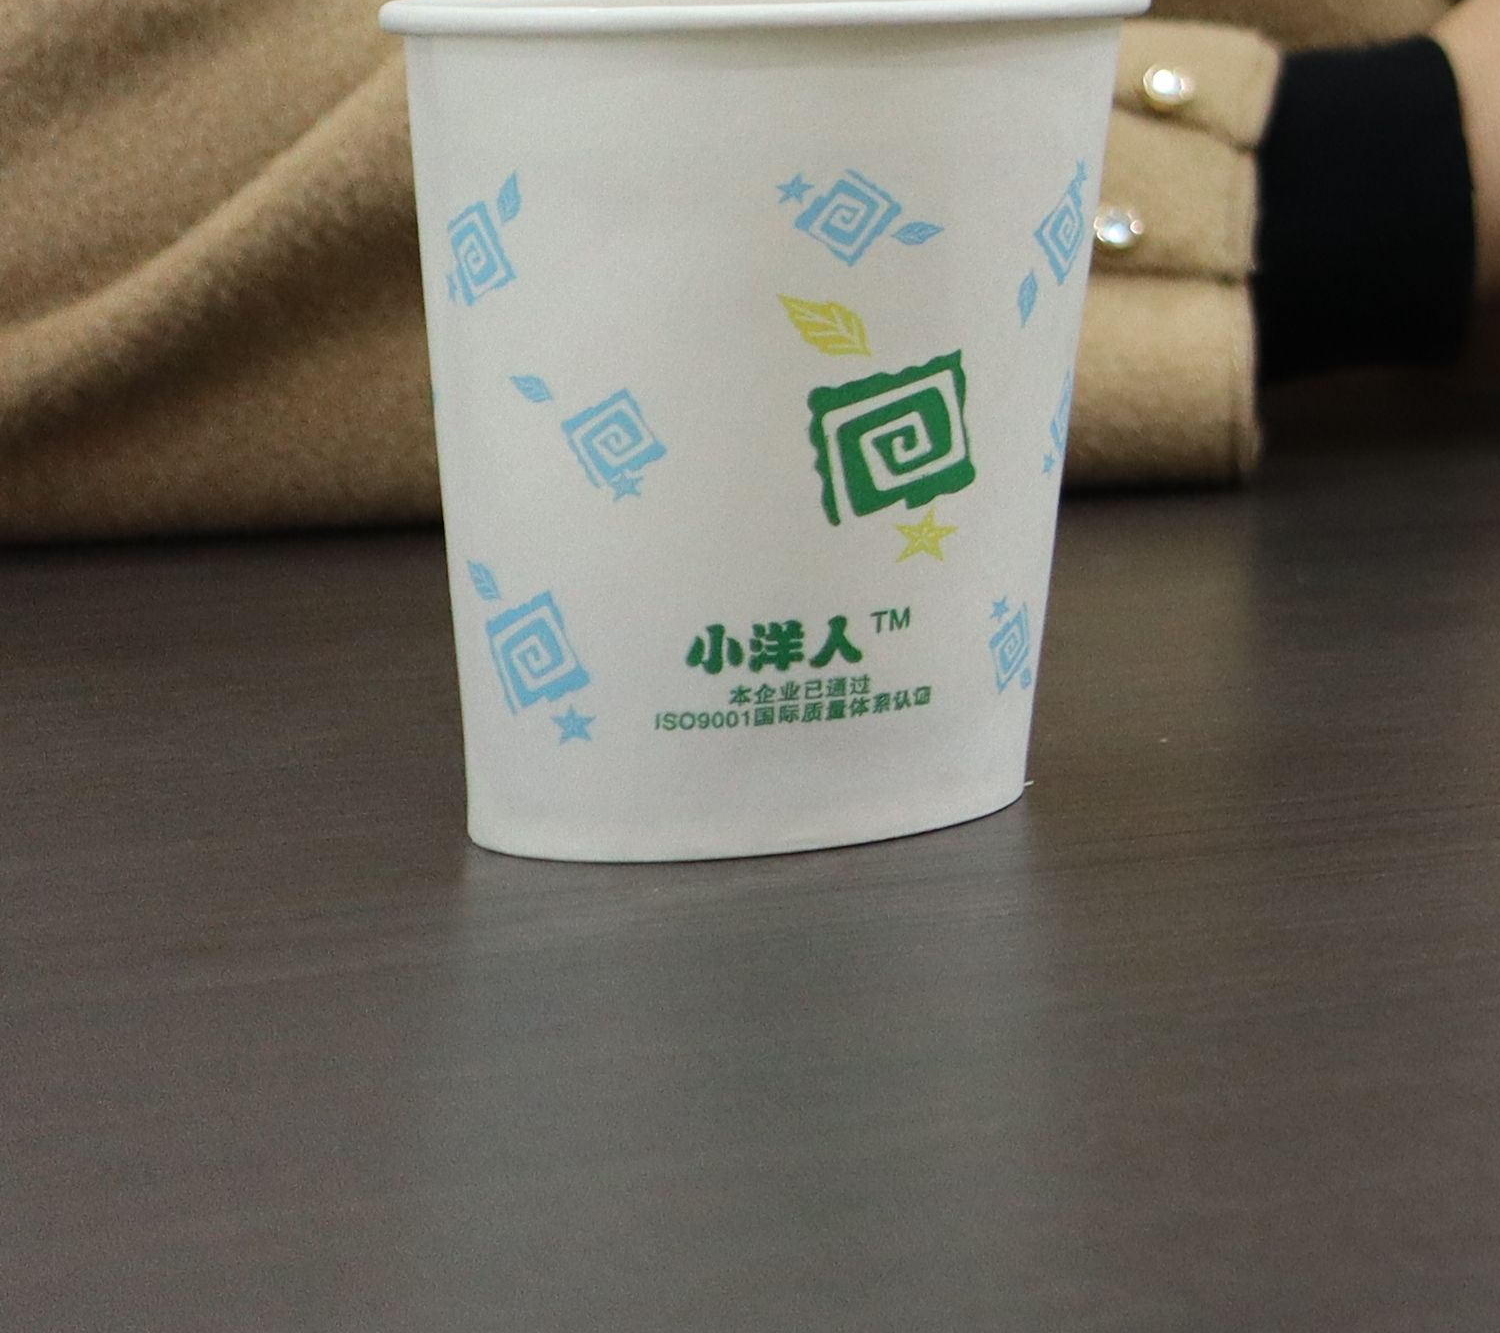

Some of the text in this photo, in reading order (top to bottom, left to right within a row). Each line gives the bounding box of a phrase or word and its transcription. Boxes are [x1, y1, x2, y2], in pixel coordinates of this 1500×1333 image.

[686, 606, 911, 675] 小洋人 TM
[729, 674, 871, 706] 本企业已通过
